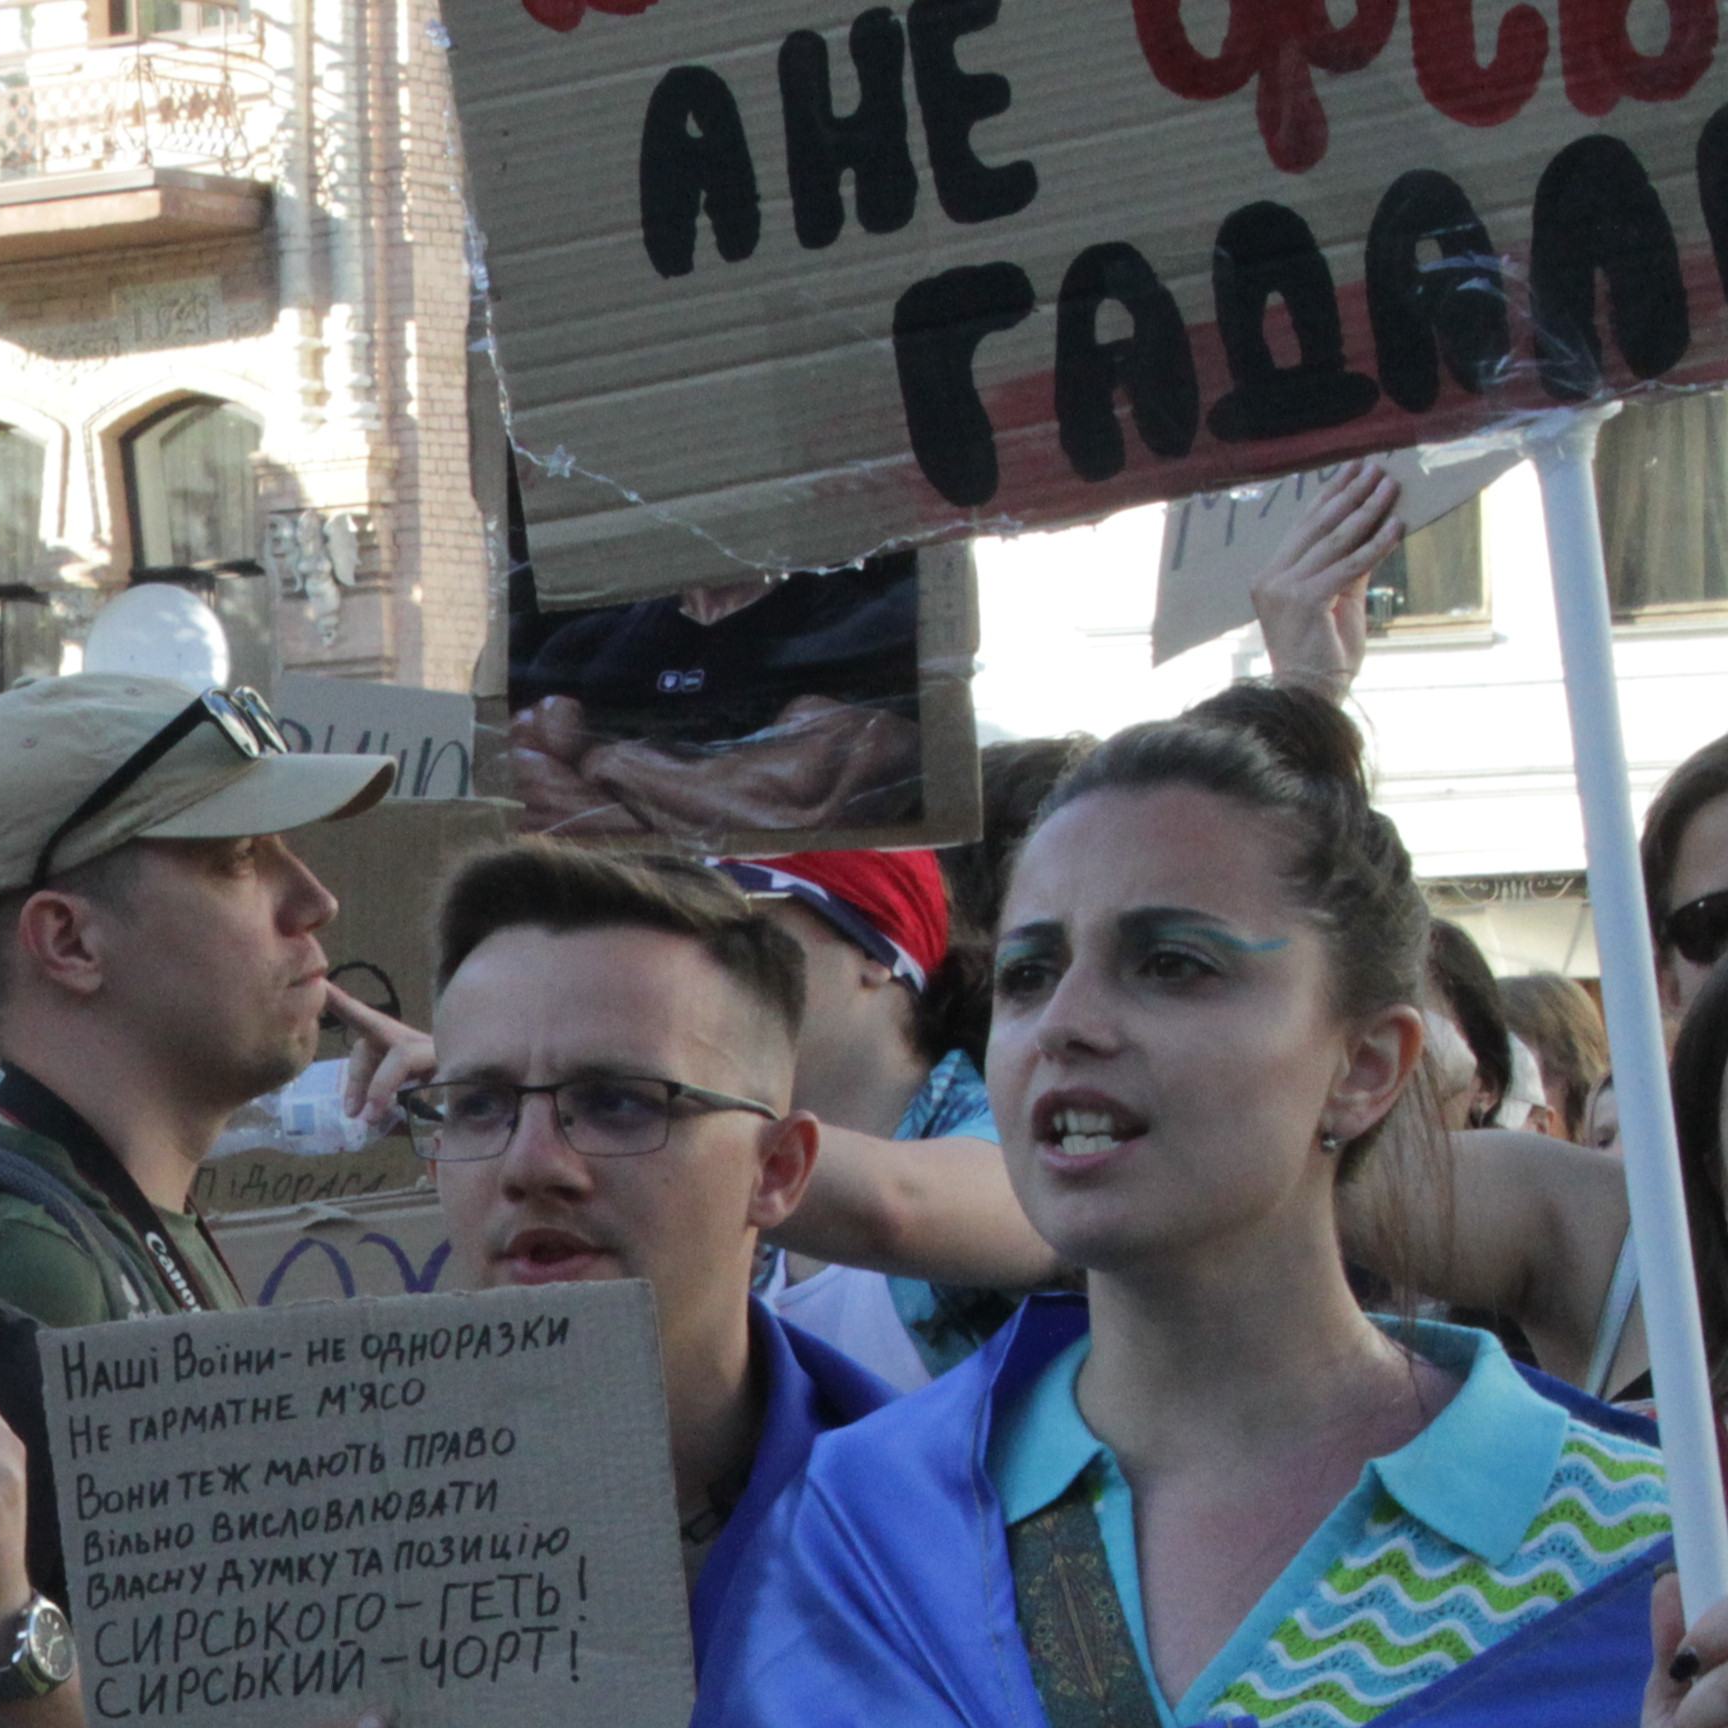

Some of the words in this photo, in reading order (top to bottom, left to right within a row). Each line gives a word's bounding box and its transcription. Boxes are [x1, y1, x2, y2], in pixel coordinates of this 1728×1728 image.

[892, 100, 1728, 508] ГАДАЛ
[361, 1315, 570, 1374] ОДНОРАЗКИ
[130, 1394, 298, 1445] ГАРМАТНЕ
[177, 1463, 251, 1500] ТЕЖ
[263, 1443, 386, 1487] МАЮТЬ
[403, 1426, 517, 1469] ПРАВО
[211, 1478, 499, 1543] ВИСЛОВЛЮВАТИ
[86, 1561, 208, 1611] ВЛАСНУ
[217, 1550, 339, 1596] ДУМКУ
[346, 1547, 384, 1578] ТА
